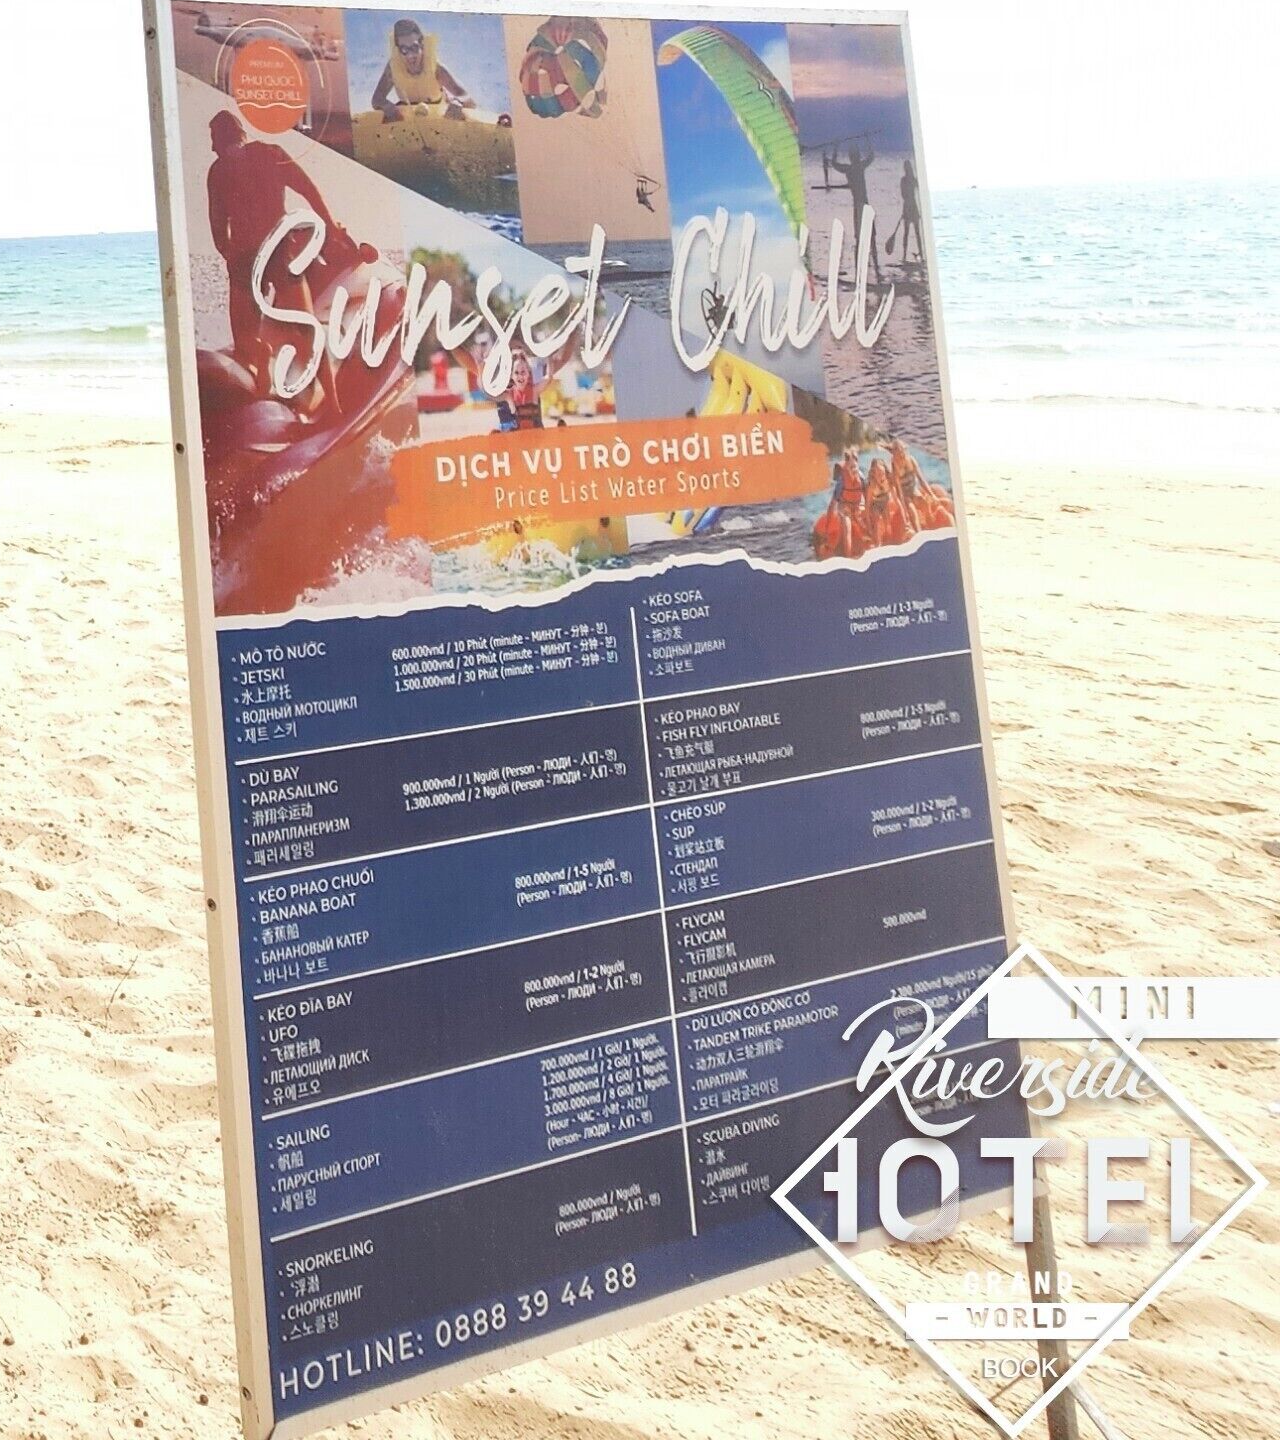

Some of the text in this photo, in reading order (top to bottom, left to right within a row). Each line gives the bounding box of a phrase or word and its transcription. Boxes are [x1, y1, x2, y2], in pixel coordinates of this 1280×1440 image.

[236, 88, 274, 100] SUNSET
[251, 204, 895, 399] Sunset Chill
[435, 421, 783, 484] DỊCH VỤ TRÒ CHƠI BIỂN
[493, 468, 740, 509] Price List Water Sports
[674, 590, 703, 604] SOFA
[650, 606, 710, 625] SOFA BOAT
[240, 648, 262, 665] MÔ
[265, 645, 283, 662] TÔ
[392, 643, 444, 661] 600.000vnd
[454, 641, 464, 653] 10
[467, 636, 487, 650] Phút
[489, 635, 523, 651] (minute
[394, 660, 454, 677] 1.000.000vnd
[463, 655, 474, 667] 20
[476, 650, 497, 665] Phút
[499, 648, 532, 664] (minute
[240, 667, 285, 685] JETSKI
[395, 675, 455, 692] 1.500.000vnd
[464, 671, 475, 683] 30
[478, 665, 499, 680] Phút
[500, 663, 534, 679] (minute
[242, 696, 357, 724] ВОДНЫЙ МОТОЦИКЛ
[686, 705, 717, 721] PHAO
[719, 702, 740, 715] BAY
[244, 721, 297, 743] 제트 스키
[662, 712, 781, 742] FISH FLY INFLOATABLE
[250, 766, 300, 786] DÙ BAY
[403, 776, 455, 796] 900.000vnd
[465, 773, 471, 785] 1
[501, 766, 535, 781] (Person
[251, 780, 338, 806] PARASAILING
[404, 791, 465, 811] 1.300.000vnd
[474, 788, 481, 799] 2
[511, 779, 545, 795] (Person
[251, 817, 350, 847] ПАРАПЛАНЕРИЗМ
[672, 825, 695, 840] SUP
[254, 841, 315, 866] 패러세일링
[674, 857, 718, 876] СТЕНДАП
[290, 878, 328, 898] PHAO
[331, 866, 374, 890] CHUỐI
[573, 864, 589, 878] 1-5
[700, 874, 720, 889] 보드
[260, 892, 356, 924] BANANA BOAT
[517, 889, 550, 907] (Person
[682, 909, 725, 929] FLYCAM
[262, 930, 370, 964] БАНАНОВЫЙ КАТЕР
[683, 927, 727, 948] FLYCAM
[264, 958, 329, 984] 바나나 보트
[583, 967, 598, 981] 1-2
[686, 954, 776, 984] ЛЕТАЮЩАЯ КАМЕРА
[327, 991, 353, 1009] BAY
[526, 994, 559, 1012] (Person
[269, 1025, 298, 1043] UFO
[694, 1005, 839, 1051] TANDEM TRIKE PARAMOTOR
[271, 1049, 370, 1085] ЛЕТАЮЩИЙ ДИСК
[273, 1080, 320, 1106] 유에프오
[276, 1124, 330, 1150] SAILING
[702, 1113, 780, 1145] SCUBA DIVING
[278, 1153, 380, 1193] ПАРУСНЫЙ СПОРТ
[706, 1163, 749, 1188] ДАЙВИНГ
[281, 1188, 316, 1212] 세일링
[709, 1184, 738, 1205] 스쿠버
[286, 1239, 374, 1278] SNORKELING
[288, 1285, 364, 1320] СНОРКЕЛИНГ
[280, 1262, 636, 1399] HOTLINE: 0888 39 44 88
